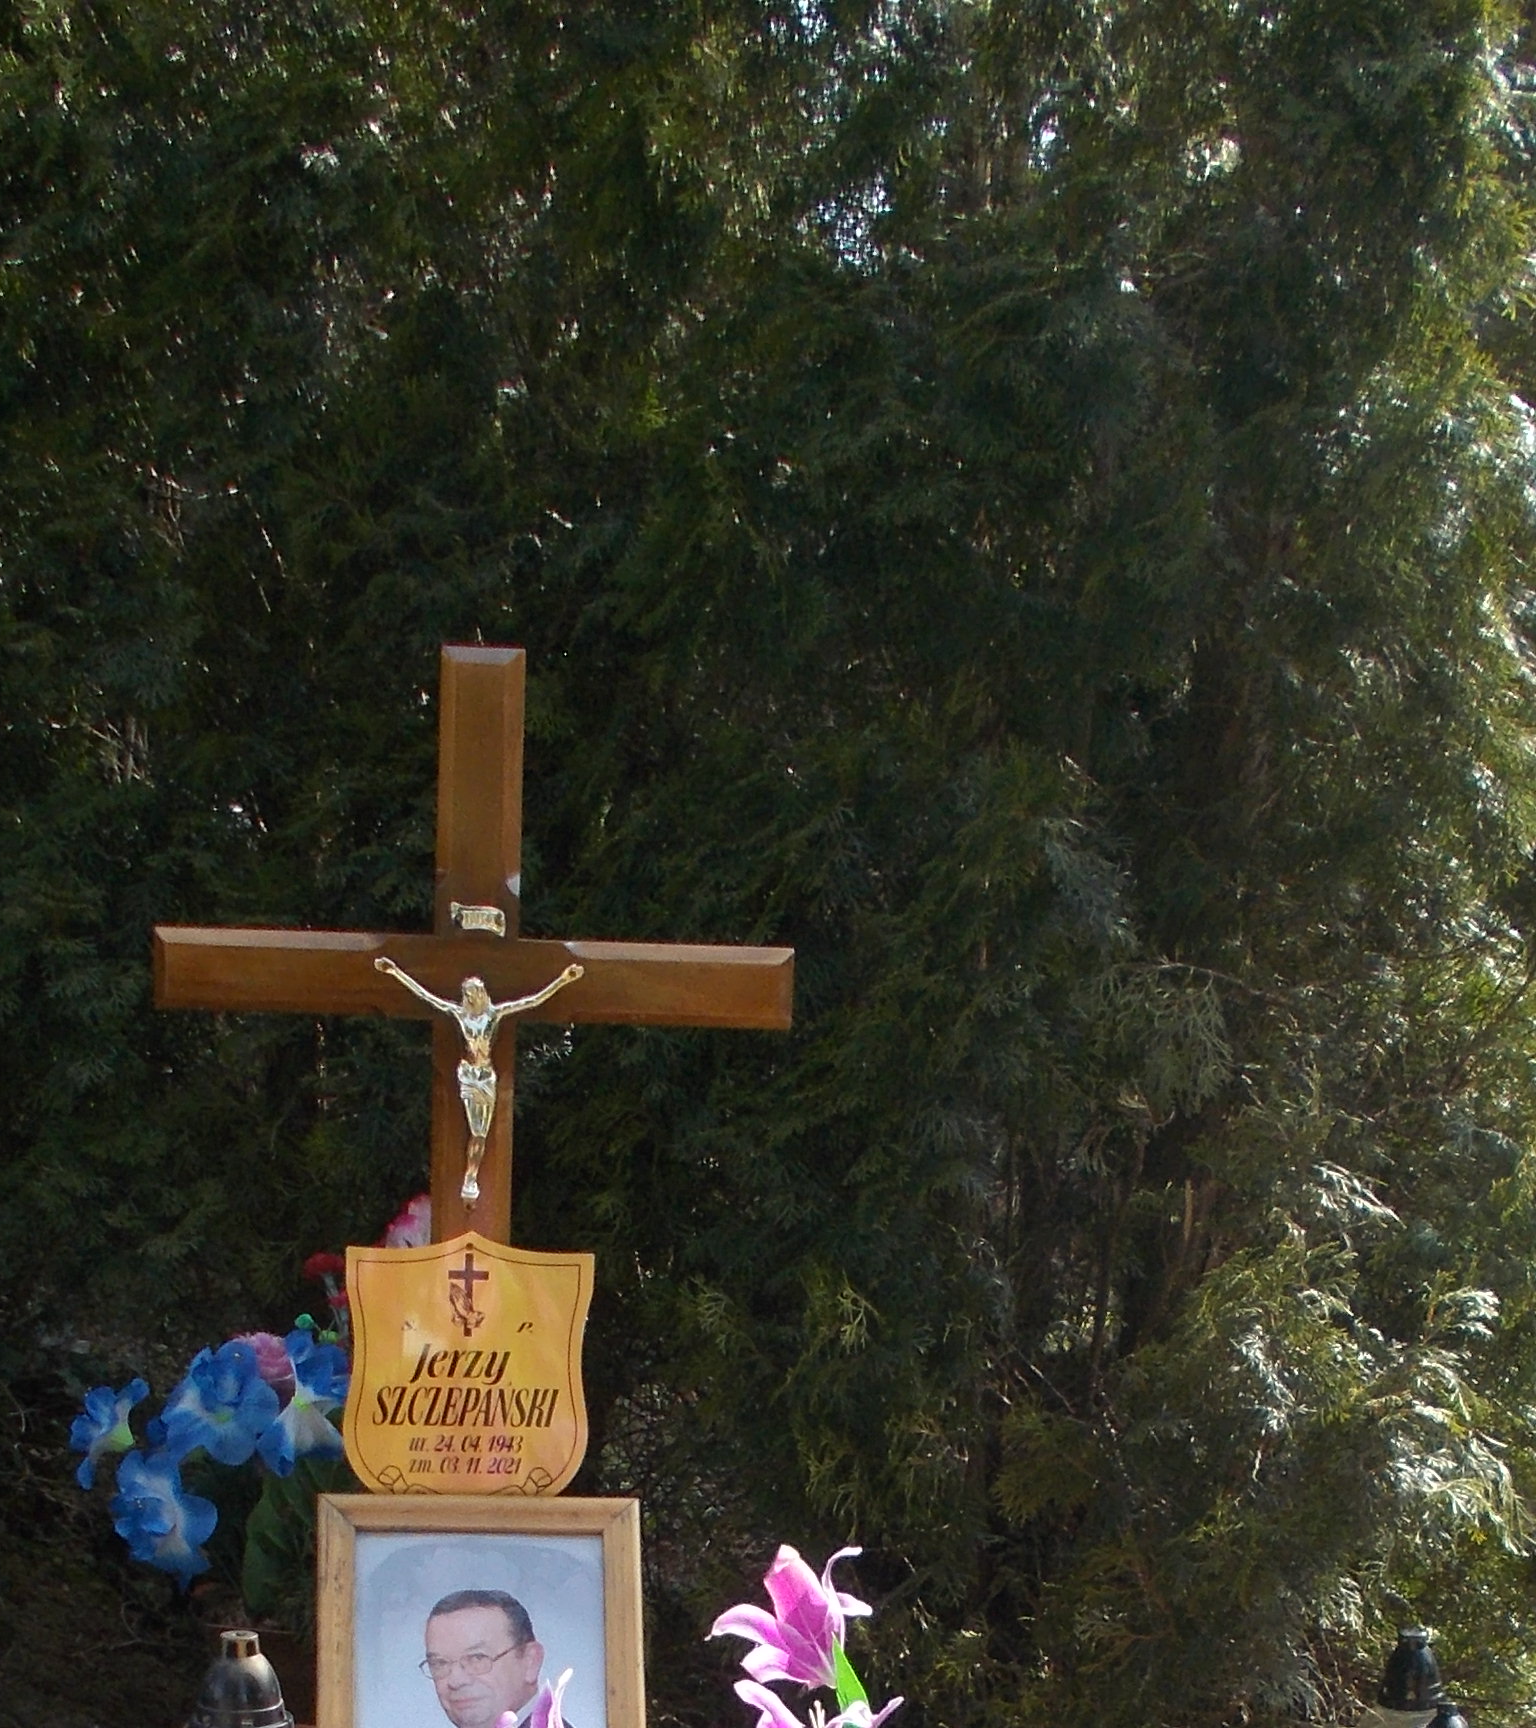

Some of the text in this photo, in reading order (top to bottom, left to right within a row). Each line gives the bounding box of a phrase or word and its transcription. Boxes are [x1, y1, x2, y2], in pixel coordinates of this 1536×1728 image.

[409, 1343, 512, 1386] Jerzy
[372, 1382, 560, 1428] SZCZEPAŃSKI
[488, 1435, 524, 1453] 1943
[487, 1457, 523, 1475] 2021
